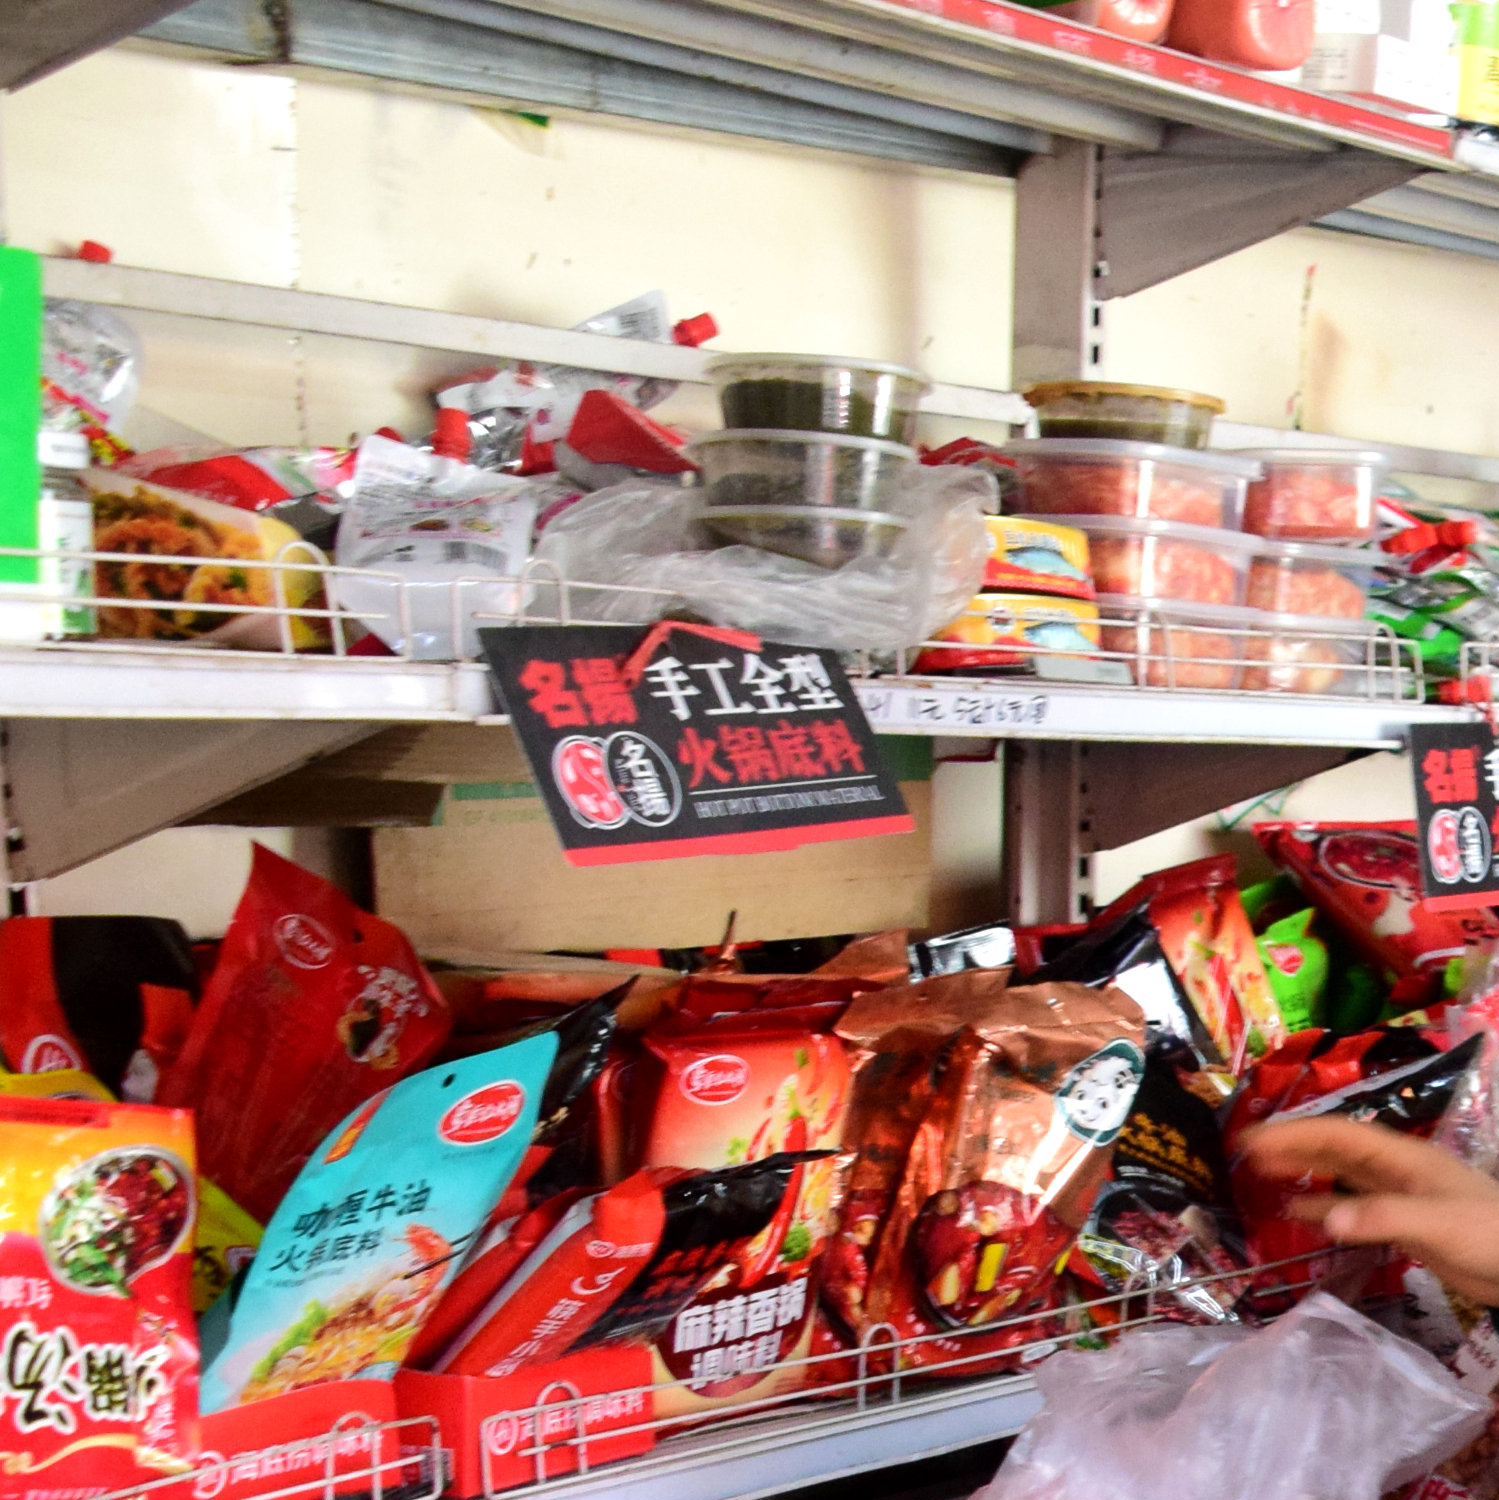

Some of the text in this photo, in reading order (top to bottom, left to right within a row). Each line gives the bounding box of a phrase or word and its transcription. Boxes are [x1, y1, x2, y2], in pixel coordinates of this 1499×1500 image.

[643, 652, 845, 721] 手工全型
[677, 718, 866, 788] 火锅底料
[674, 1276, 808, 1354] 麻辣香锅
